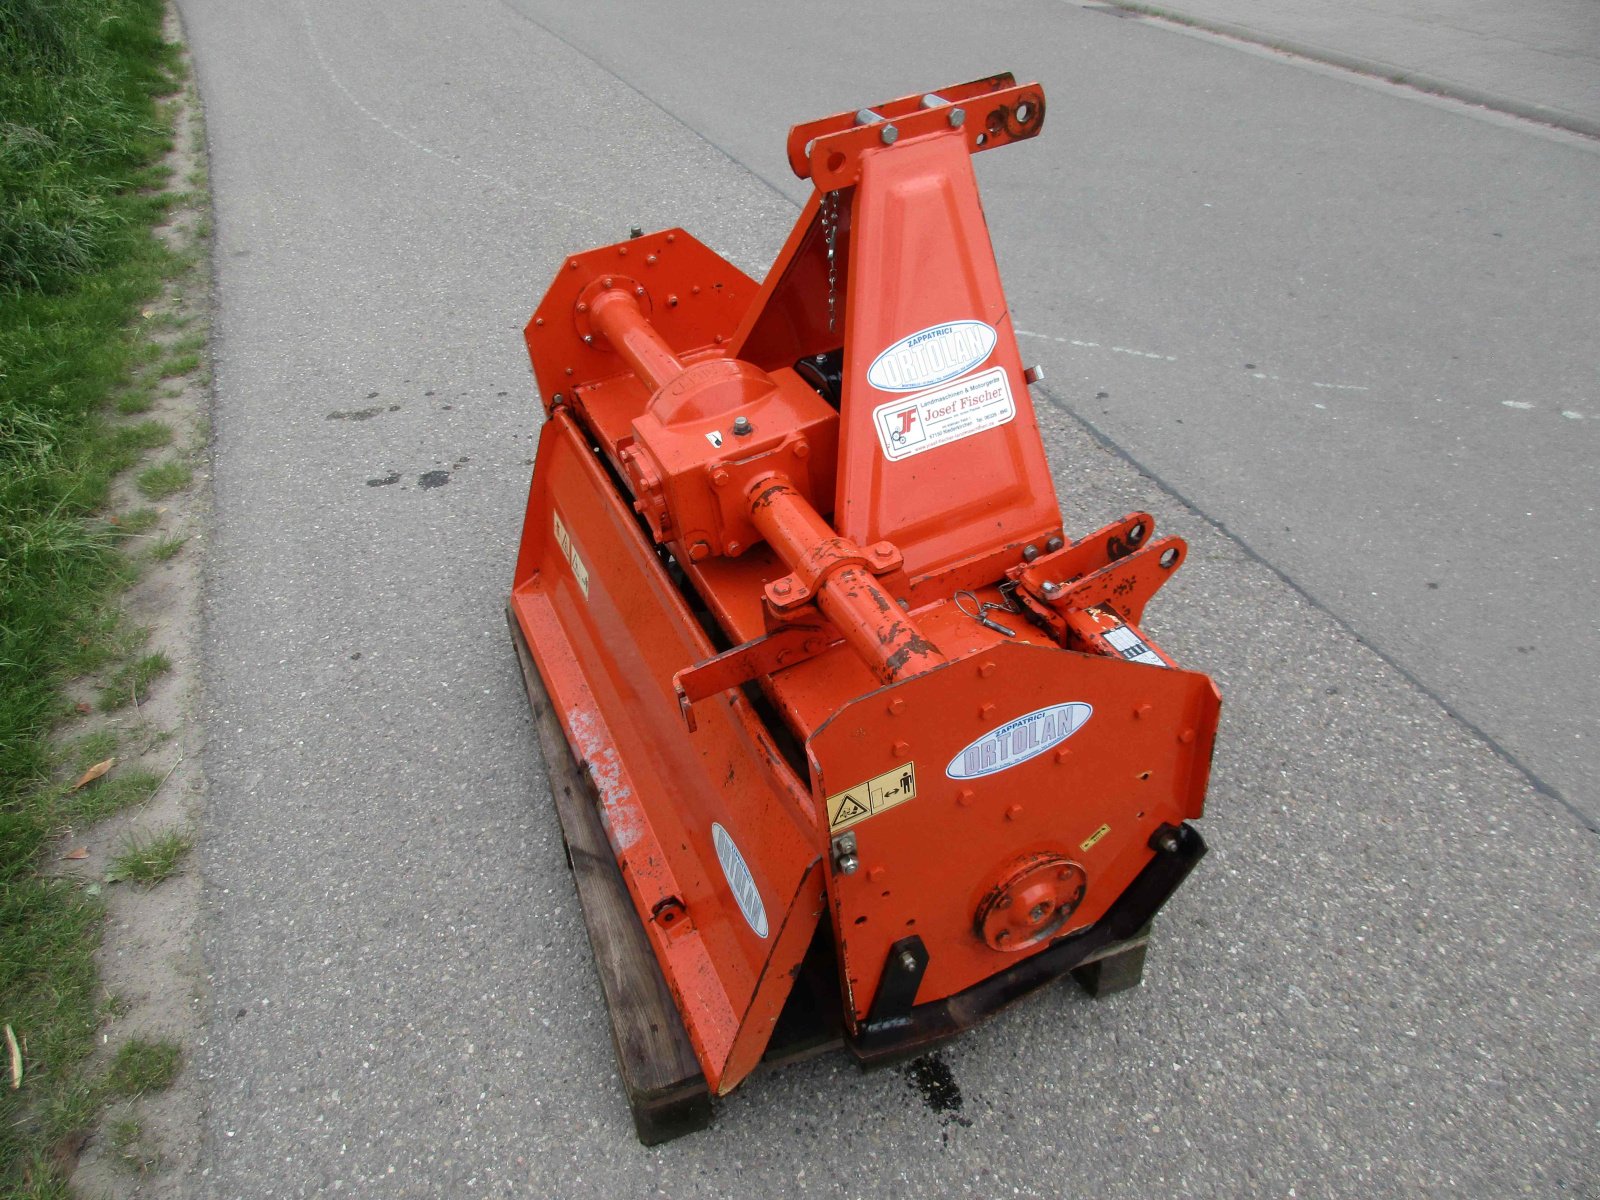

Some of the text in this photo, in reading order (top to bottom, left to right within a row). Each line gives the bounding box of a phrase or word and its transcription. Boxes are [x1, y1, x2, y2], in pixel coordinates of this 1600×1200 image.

[907, 327, 953, 348] ZAPPATRICI
[881, 325, 986, 387] ORTOLAN
[924, 400, 957, 421] Josef
[960, 387, 1002, 410] Fischer
[963, 705, 1074, 776] ORTOLAN
[995, 712, 1046, 738] ZAPPATRICI
